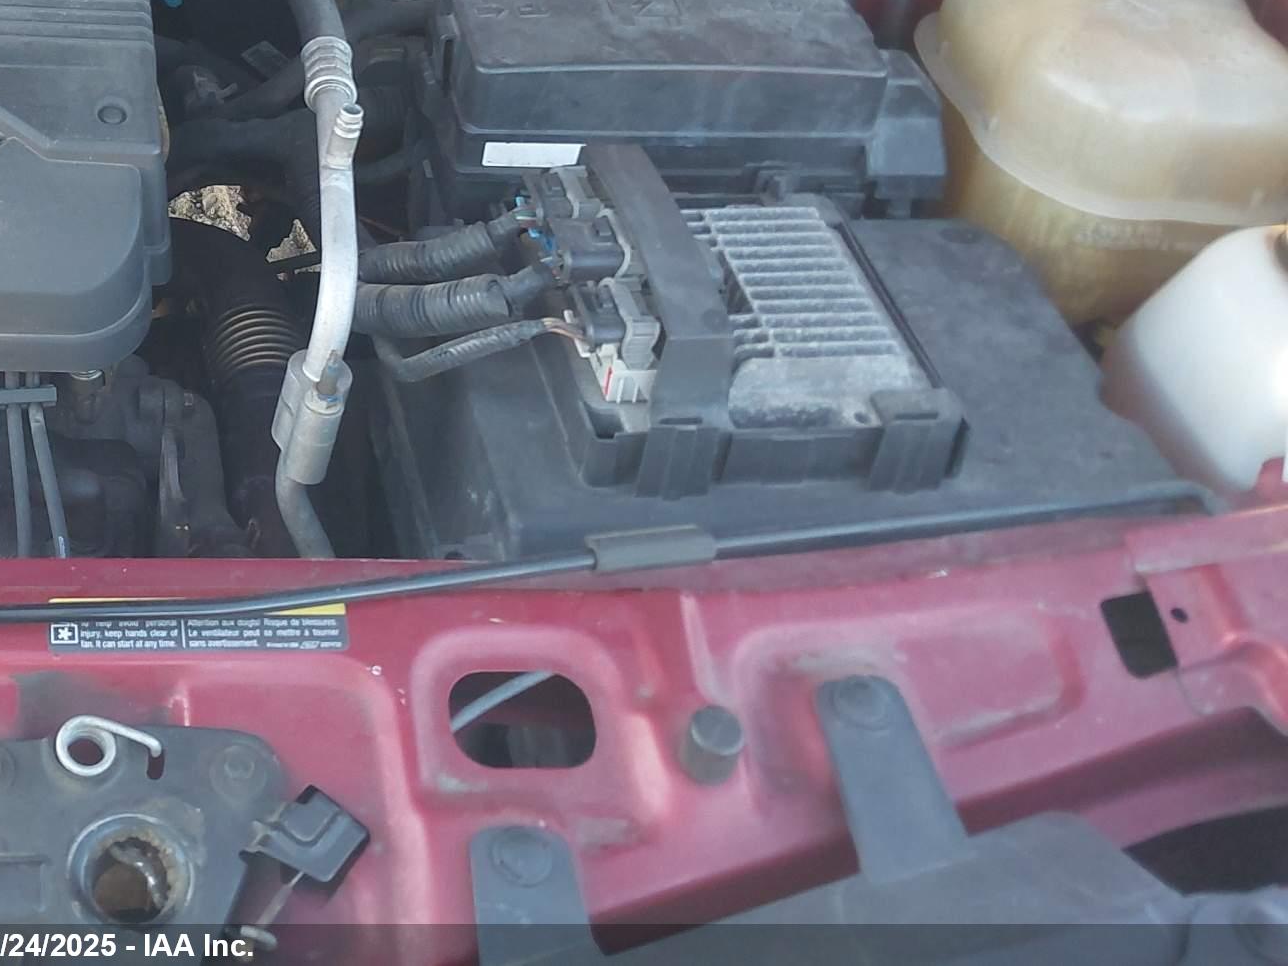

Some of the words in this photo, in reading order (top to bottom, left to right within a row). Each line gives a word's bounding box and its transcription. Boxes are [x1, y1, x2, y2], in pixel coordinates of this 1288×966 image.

[104, 629, 123, 640] keep
[125, 629, 147, 638] hands
[150, 629, 168, 638] clear
[169, 628, 179, 637] of
[188, 629, 198, 637] Le
[243, 629, 260, 639] peut
[276, 629, 301, 637] mettre
[312, 629, 340, 637] tourner
[80, 640, 95, 648] fan.
[95, 640, 102, 648] It
[116, 640, 135, 648] start
[135, 640, 143, 648] at
[143, 641, 158, 650] any
[158, 639, 176, 648] time.
